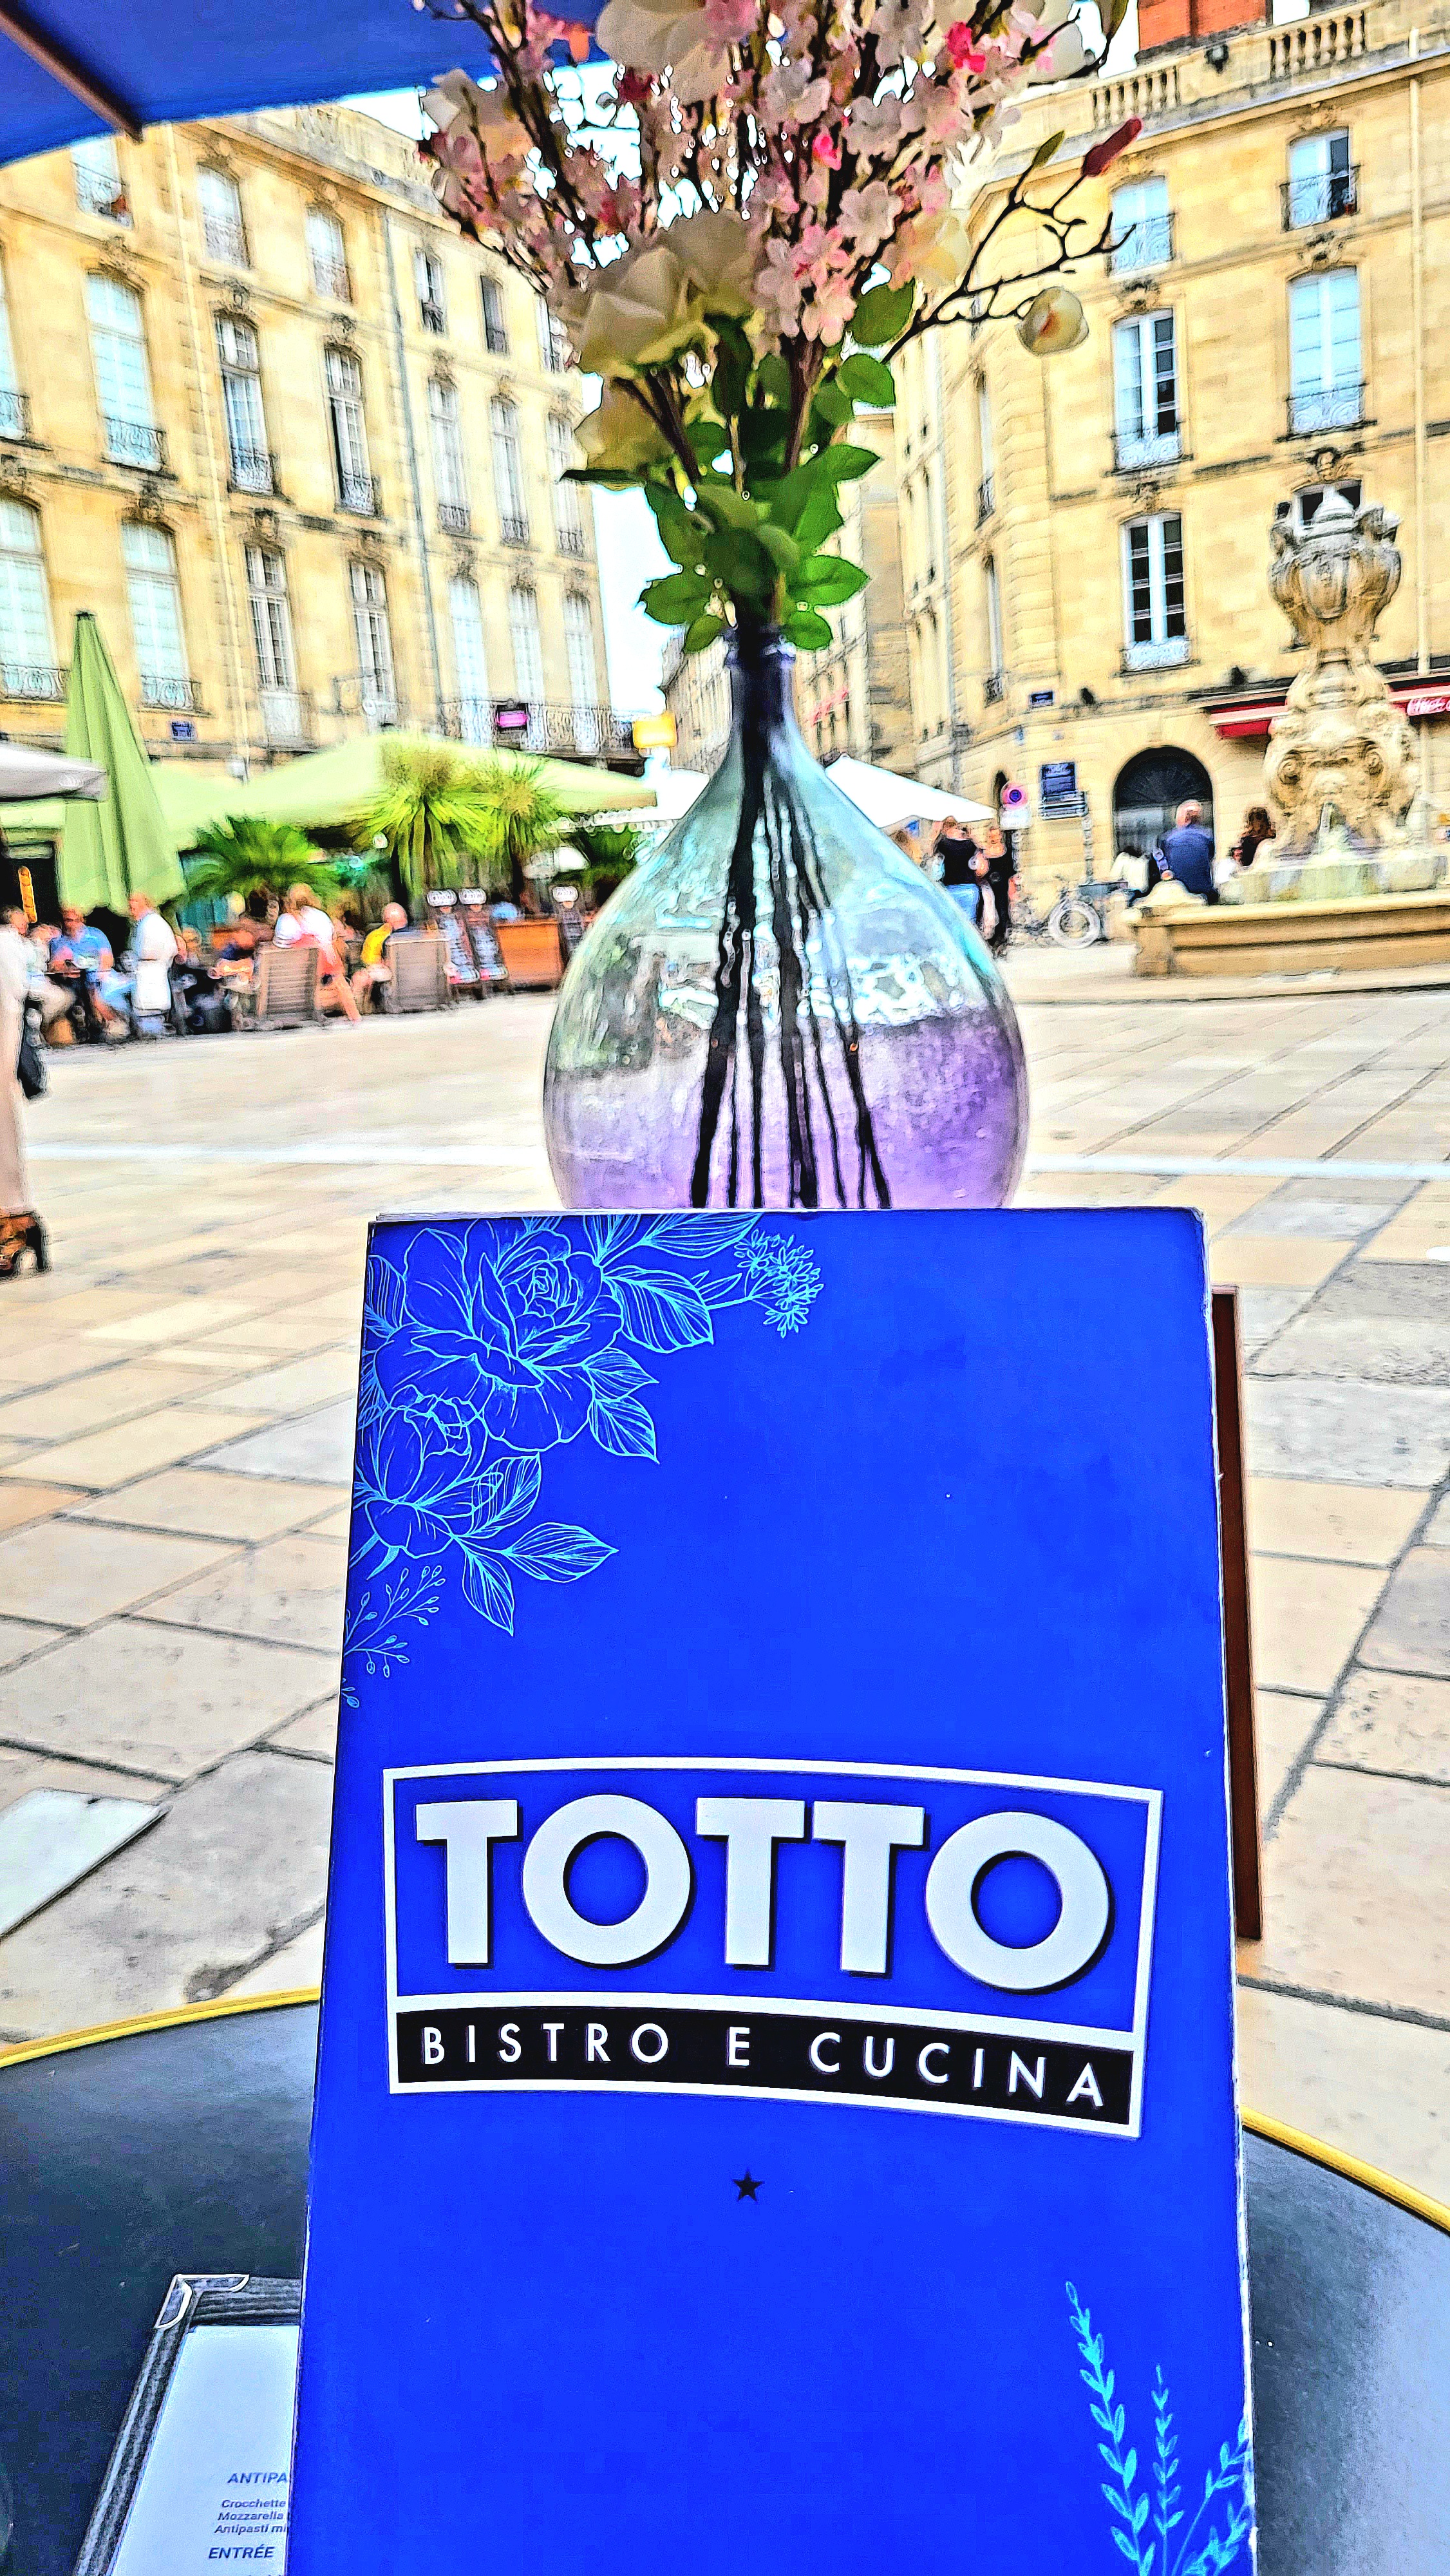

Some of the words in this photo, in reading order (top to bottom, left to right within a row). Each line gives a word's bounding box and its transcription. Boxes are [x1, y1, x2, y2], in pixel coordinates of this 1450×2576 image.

[415, 1794, 1109, 1991] TOTTO
[424, 2023, 669, 2064] BISTRO
[728, 2026, 750, 2067] E
[810, 2032, 1104, 2107] CUCINA
[221, 2499, 286, 2508] Crocchette
[218, 2512, 284, 2521] Mozzarella
[214, 2524, 269, 2535] Antipasti
[209, 2544, 275, 2559] ENTRÉE
